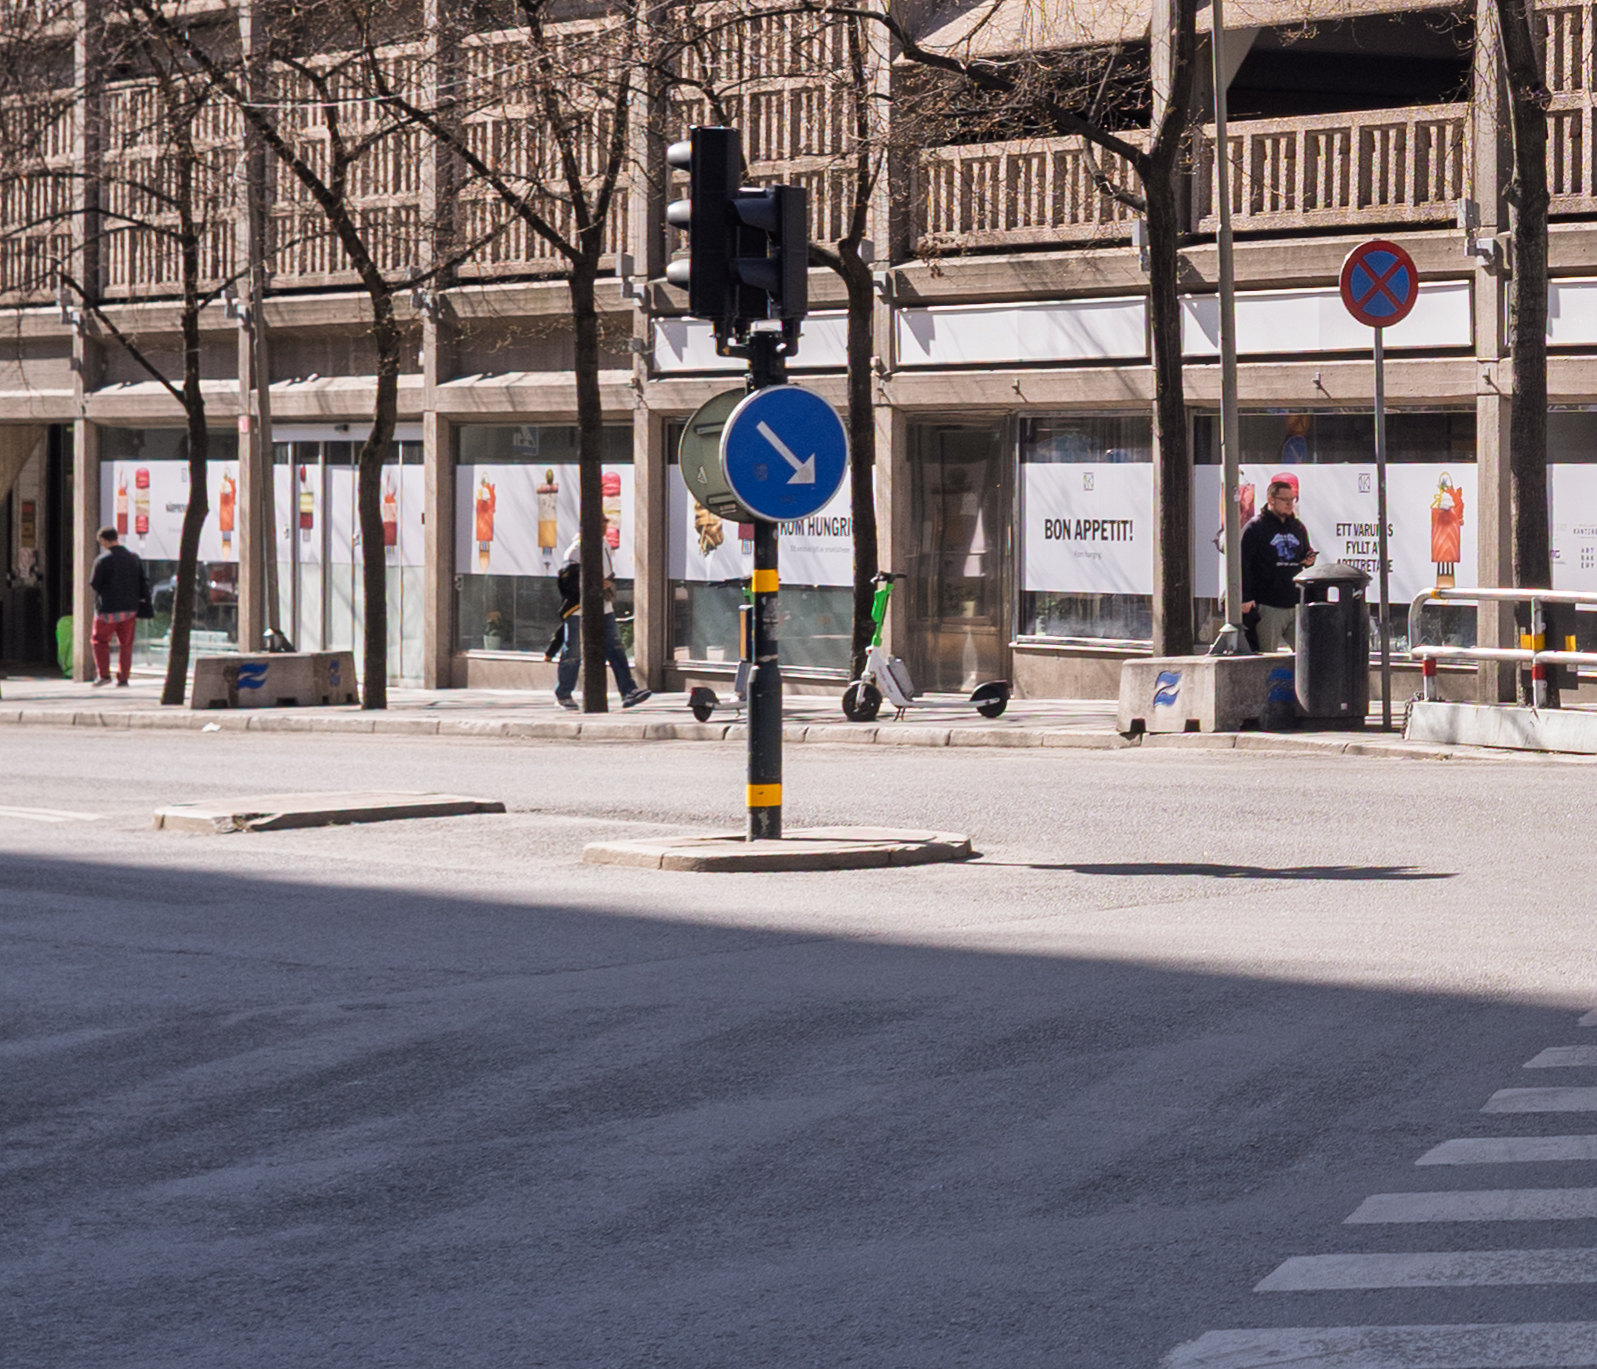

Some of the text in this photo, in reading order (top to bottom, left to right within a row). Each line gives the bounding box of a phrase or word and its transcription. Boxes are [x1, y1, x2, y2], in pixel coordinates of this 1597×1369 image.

[808, 517, 851, 537] HUNGRI
[1045, 519, 1134, 542] BON APPETIT!
[1336, 523, 1394, 537] ETT VARUS
[1346, 541, 1371, 555] FYLLT
